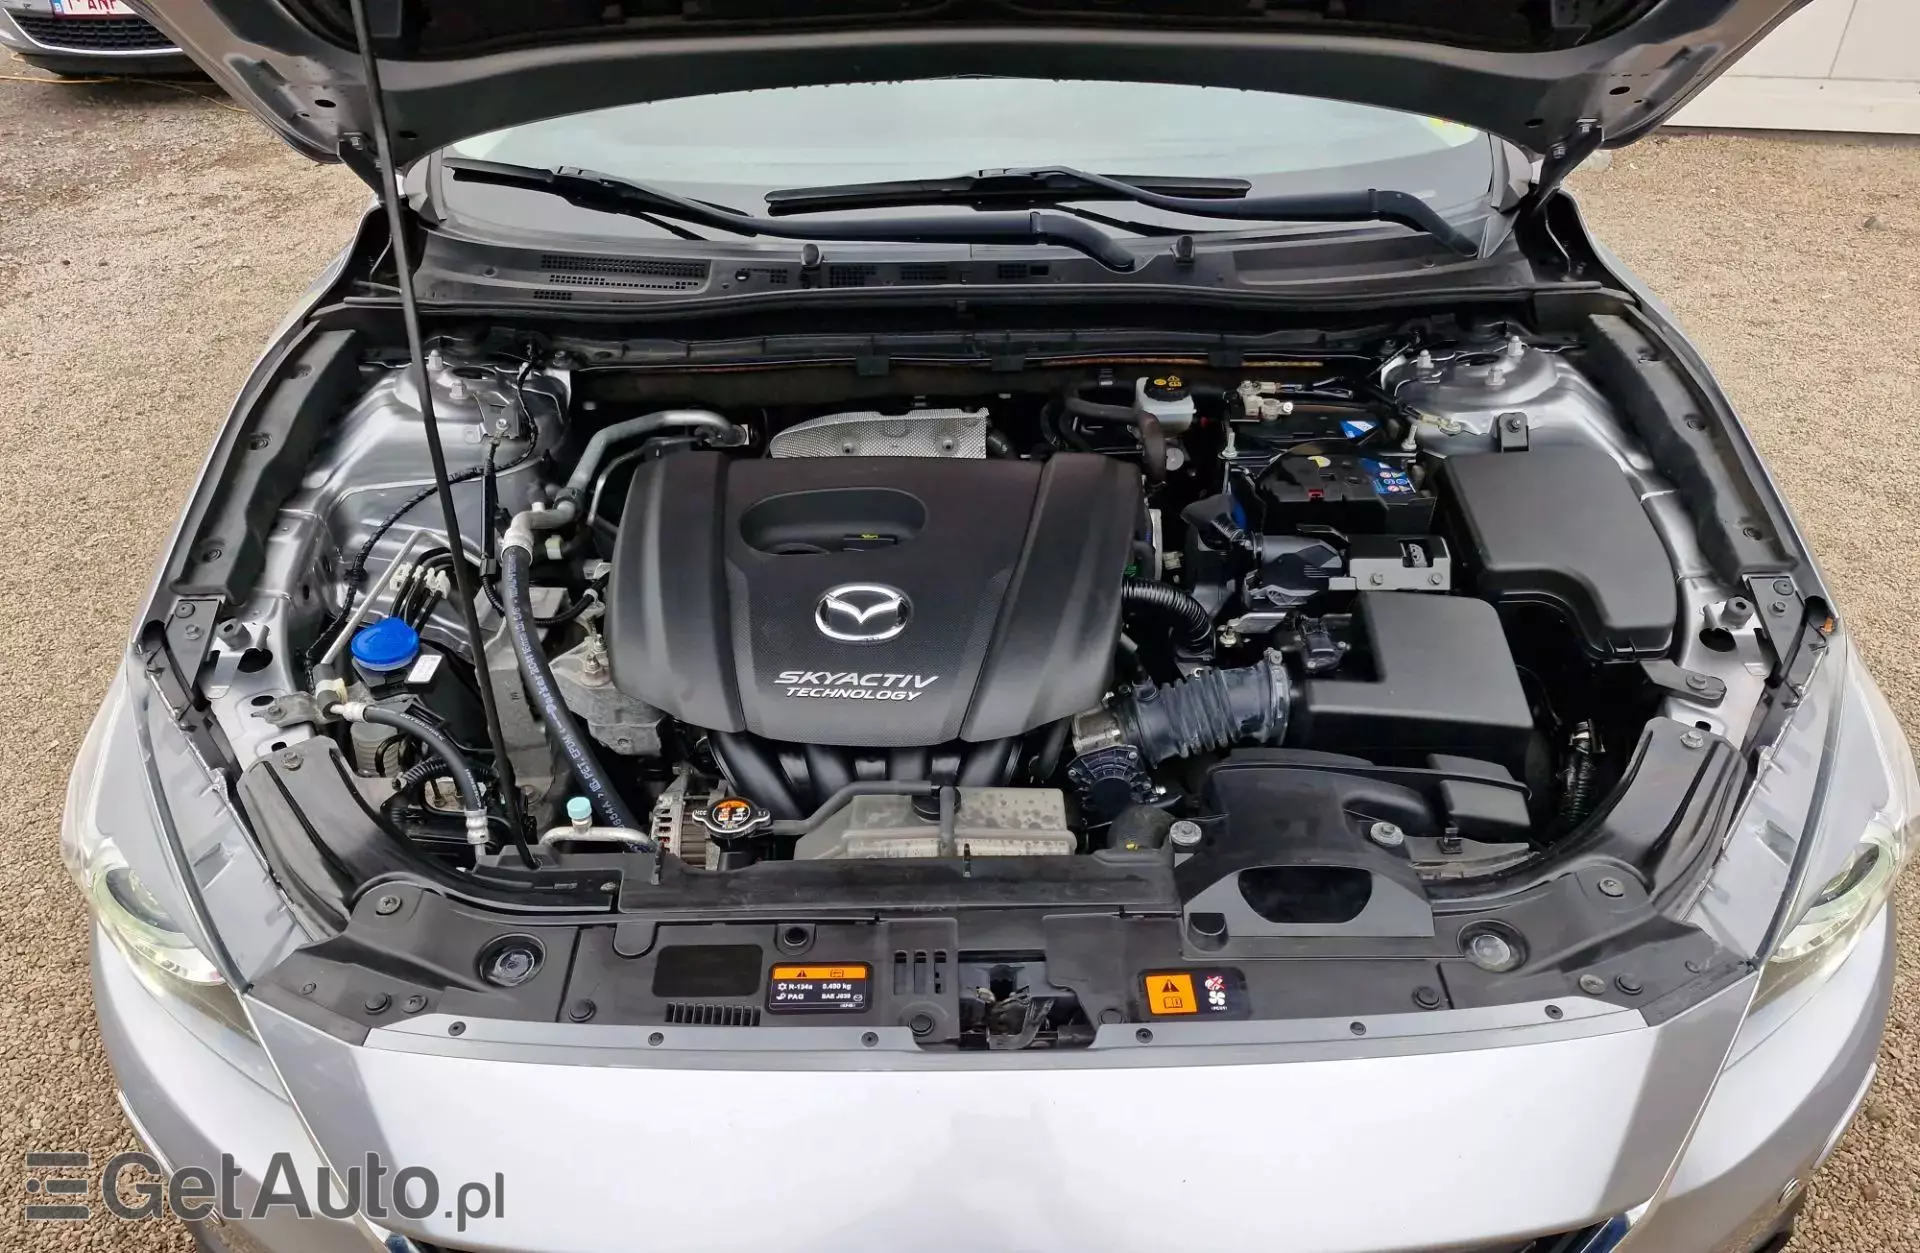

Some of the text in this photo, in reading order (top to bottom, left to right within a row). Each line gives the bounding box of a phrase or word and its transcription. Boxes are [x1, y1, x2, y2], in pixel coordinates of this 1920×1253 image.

[774, 671, 939, 689] SKYACTIV
[785, 687, 922, 701] TECHNOLOGY
[842, 982, 852, 990] kg
